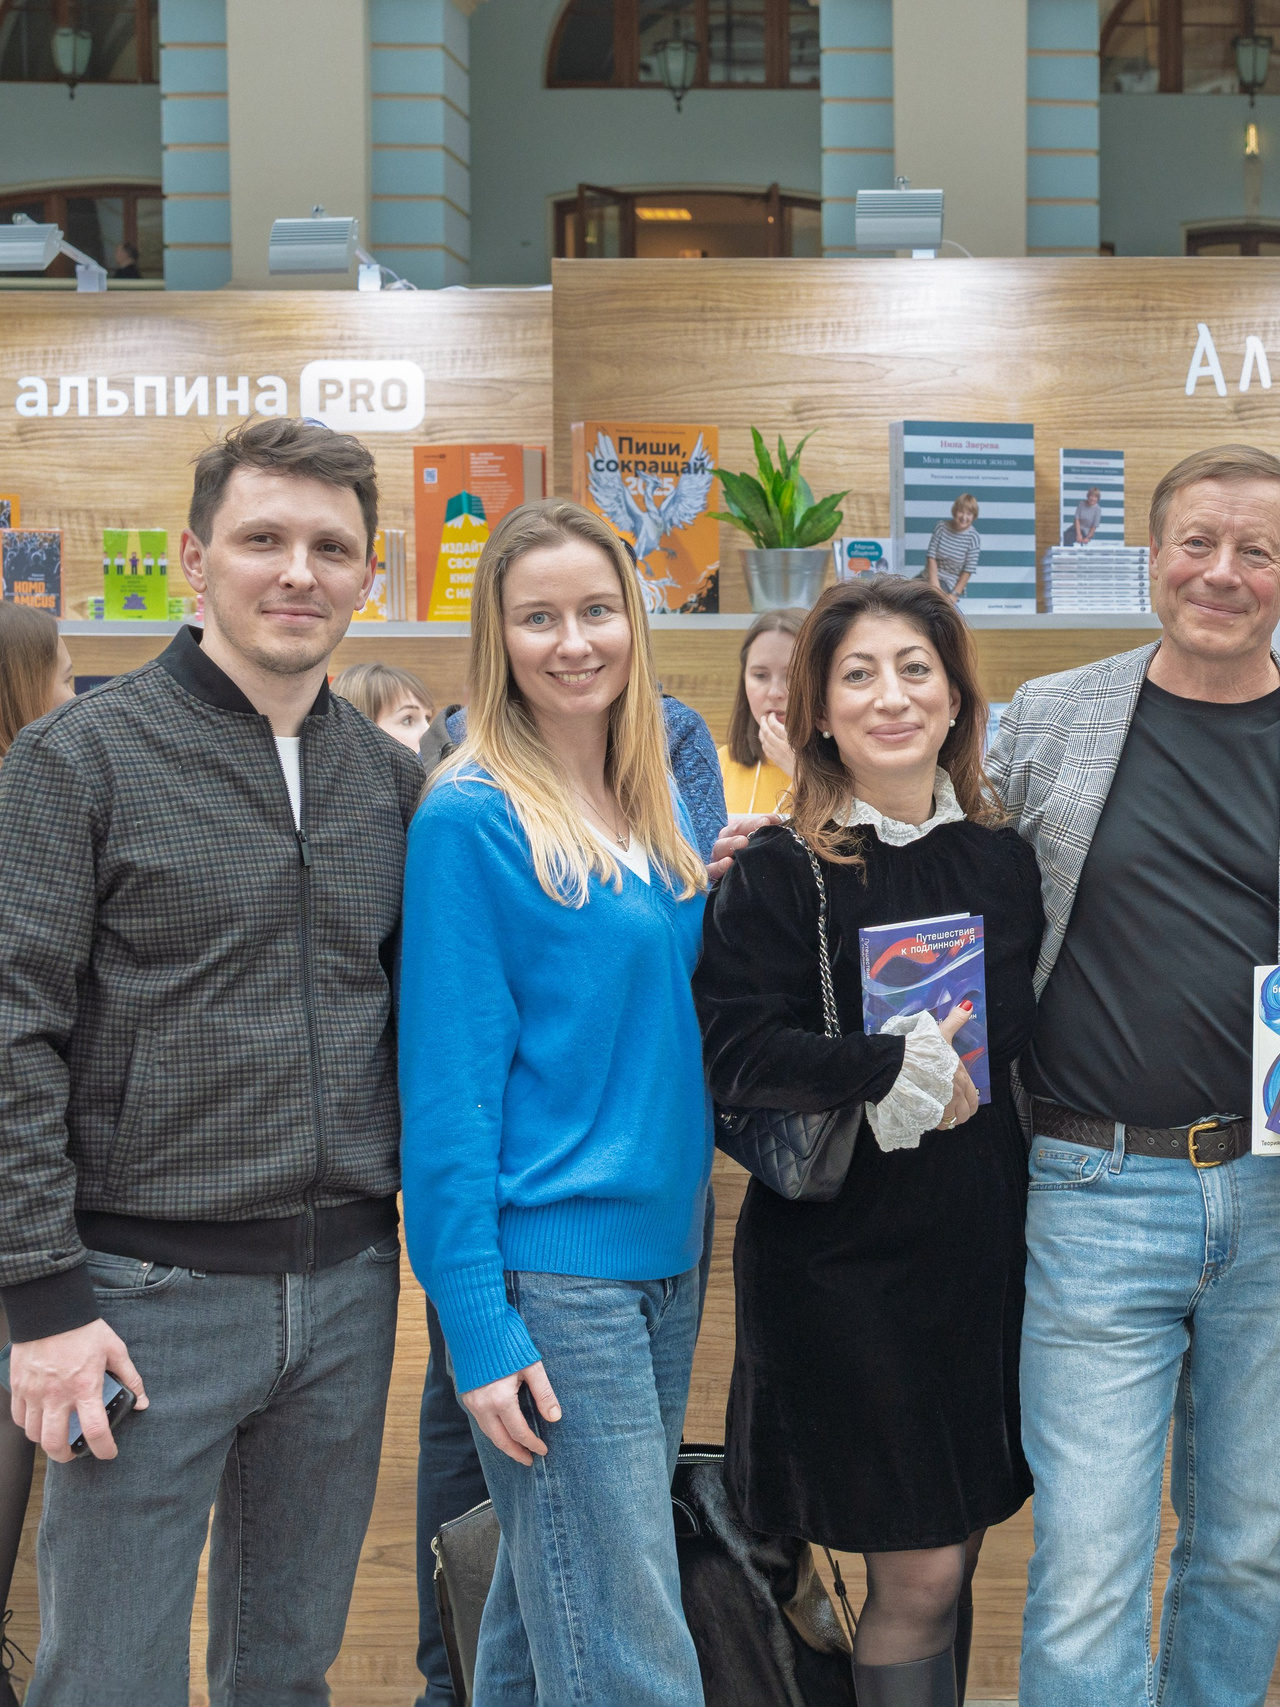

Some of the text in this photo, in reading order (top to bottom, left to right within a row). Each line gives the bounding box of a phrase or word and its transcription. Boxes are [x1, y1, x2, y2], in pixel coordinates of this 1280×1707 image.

[15, 374, 289, 418] альпина
[318, 377, 409, 413] PRO
[618, 436, 687, 459] Пиши,
[940, 440, 1000, 452] Нина Зверева
[593, 456, 706, 478] сокращай
[922, 455, 1018, 467] Моя полосатая жизнь
[440, 539, 486, 556] ИЗДАЙТ
[13, 580, 46, 594] HOMO
[449, 572, 476, 585] КНИ
[13, 594, 57, 609] AMICUS
[444, 587, 472, 600] С НА
[915, 927, 975, 945] Путешествие
[901, 934, 976, 956] к подлинному Я
